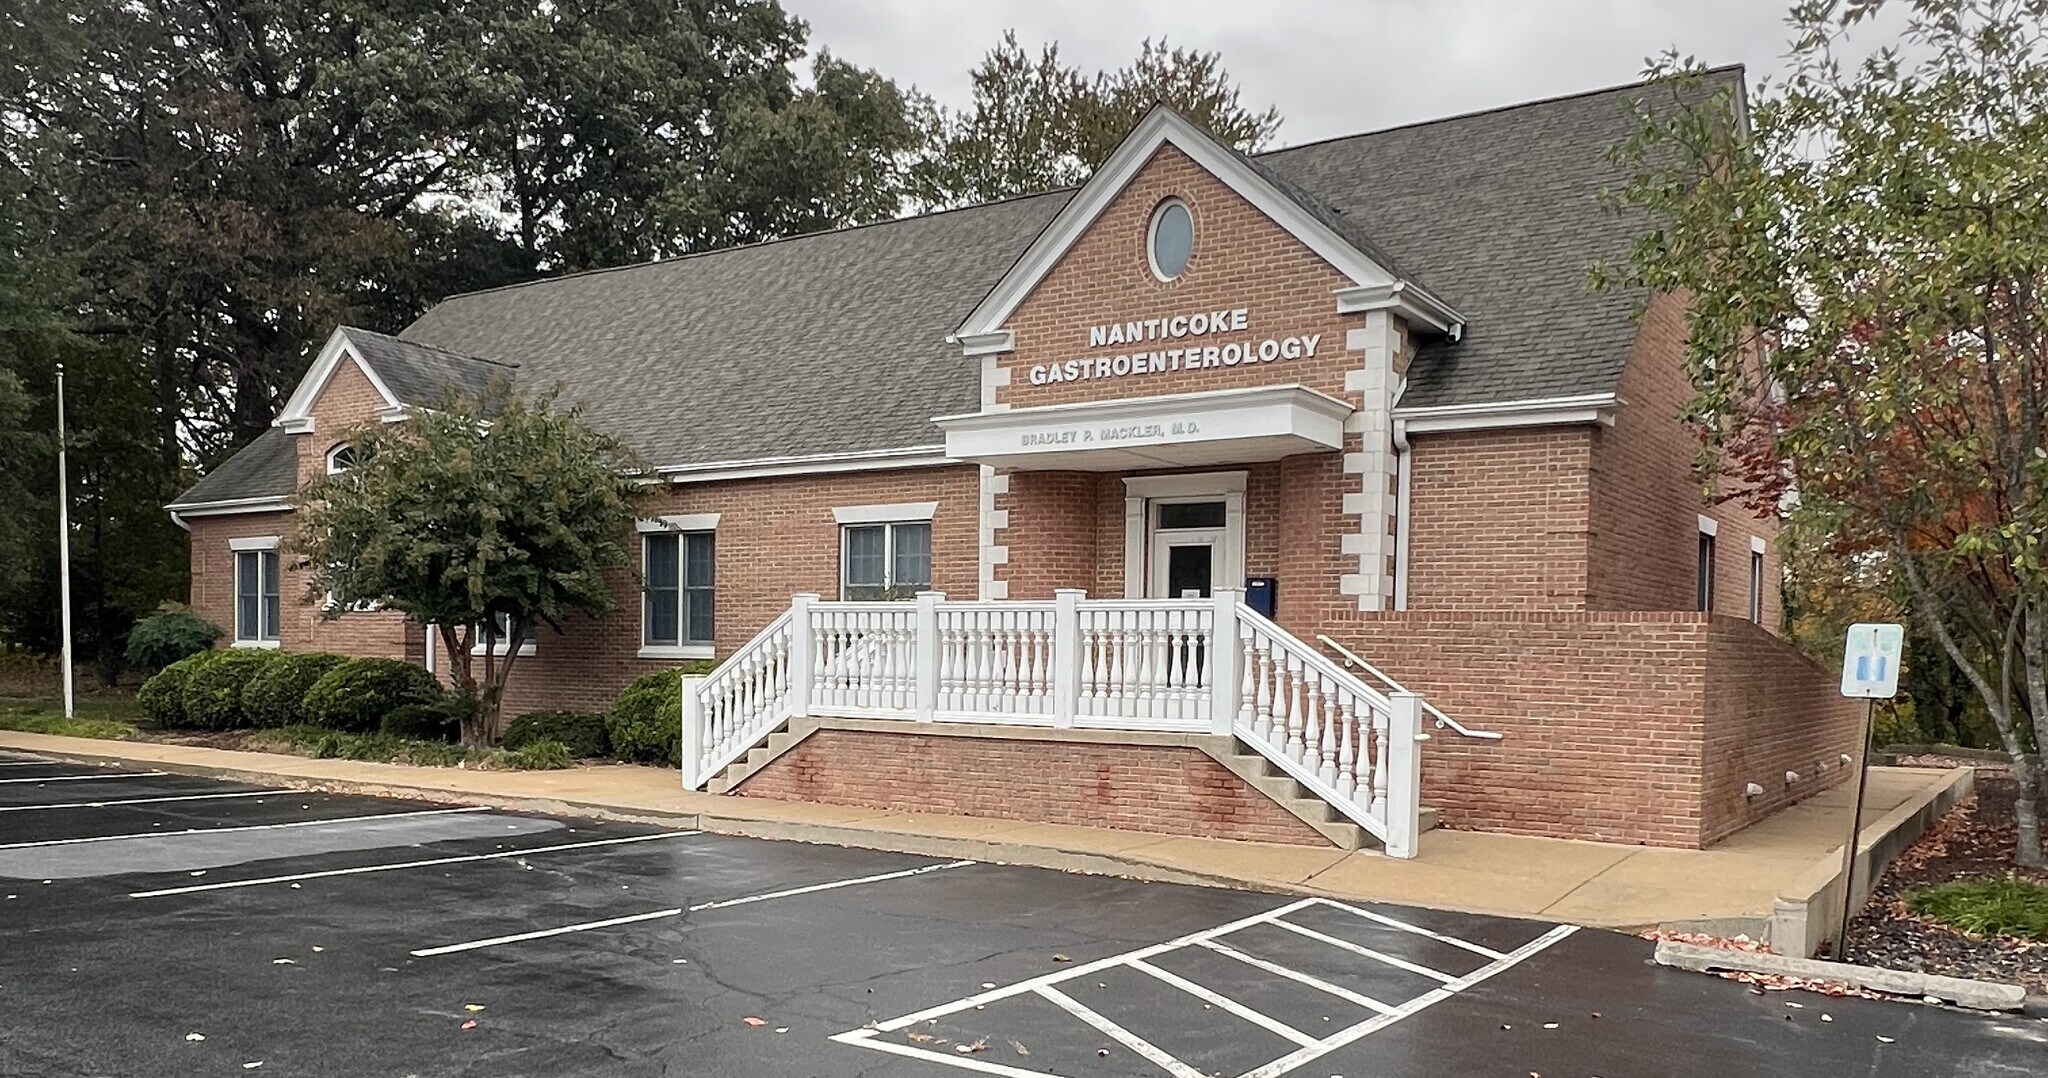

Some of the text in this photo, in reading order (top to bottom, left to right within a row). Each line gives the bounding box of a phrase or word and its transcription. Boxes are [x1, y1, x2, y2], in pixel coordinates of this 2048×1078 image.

[1090, 308, 1249, 347] NANTICOKE
[1029, 334, 1322, 386] GASTROENTEROLOGY
[1021, 430, 1077, 447] BRADLEY
[1083, 428, 1094, 442] P.
[1100, 425, 1164, 441] MACKLER,
